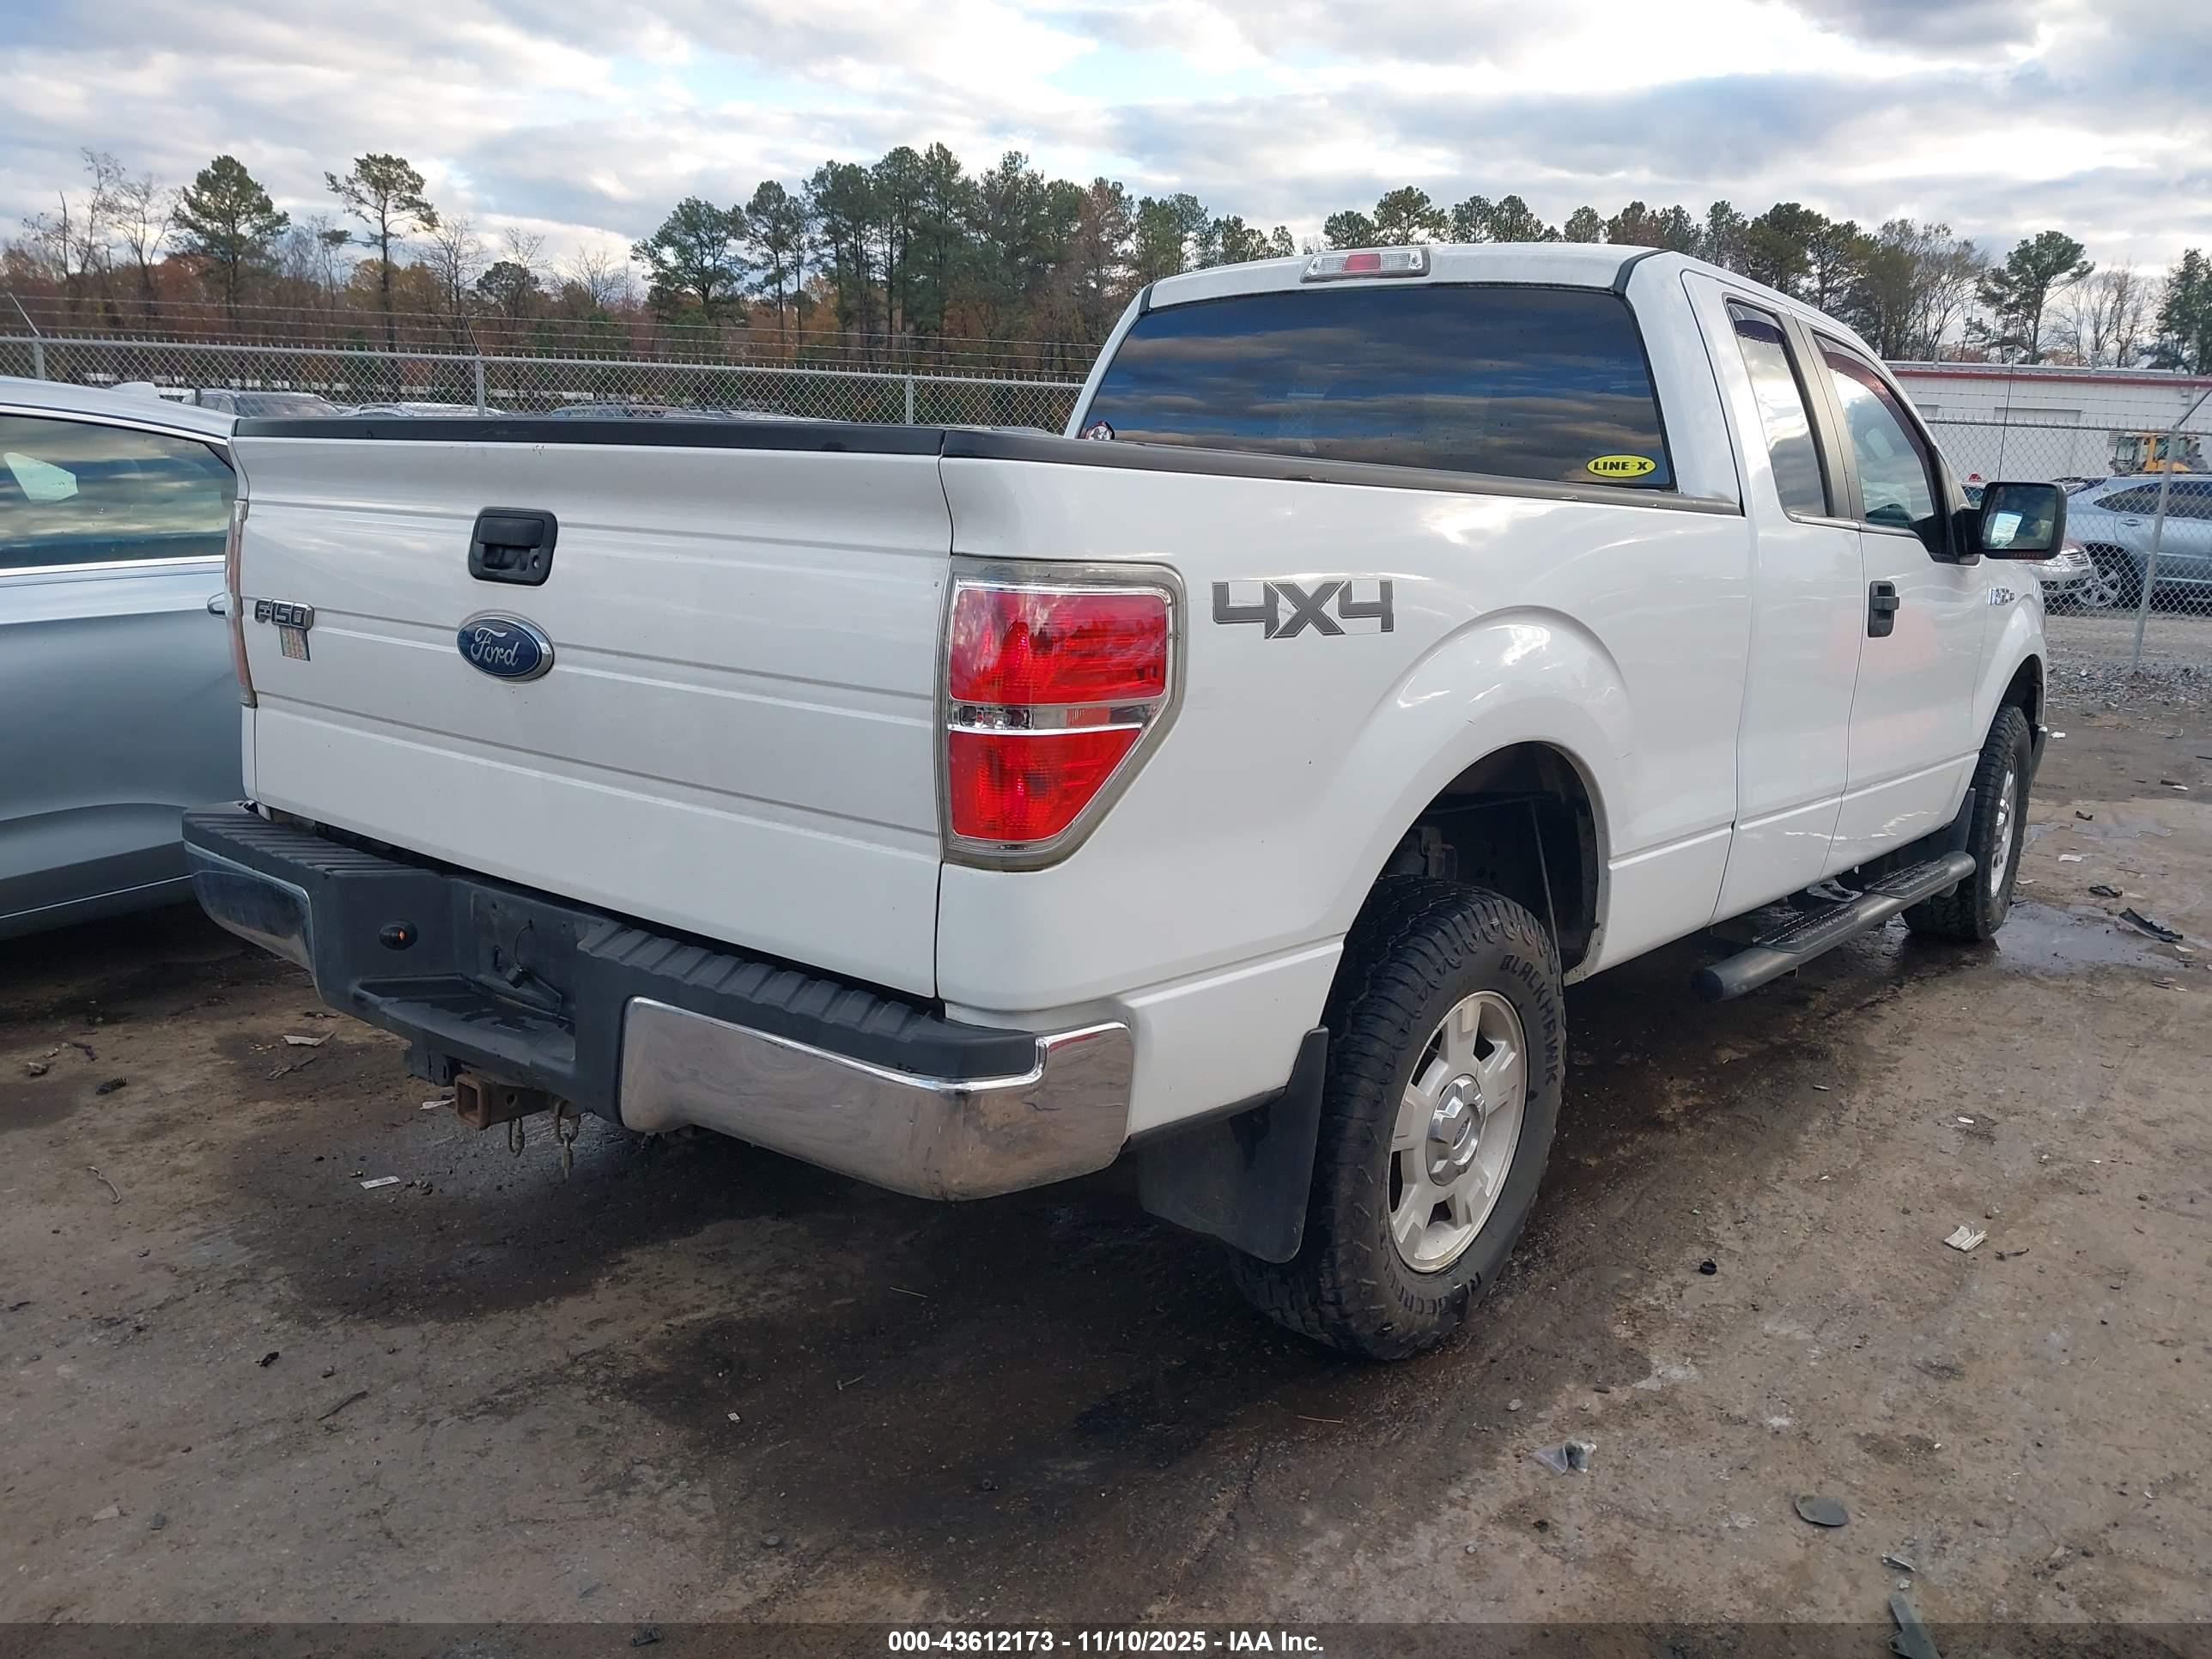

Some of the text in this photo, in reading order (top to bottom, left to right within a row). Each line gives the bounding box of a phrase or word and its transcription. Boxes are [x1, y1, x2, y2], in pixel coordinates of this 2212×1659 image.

[1593, 460, 1650, 471] LINE-X
[1211, 580, 1395, 641] 4X4
[470, 625, 521, 668] Ford
[1498, 953, 1559, 1086] BLACKHAWK
